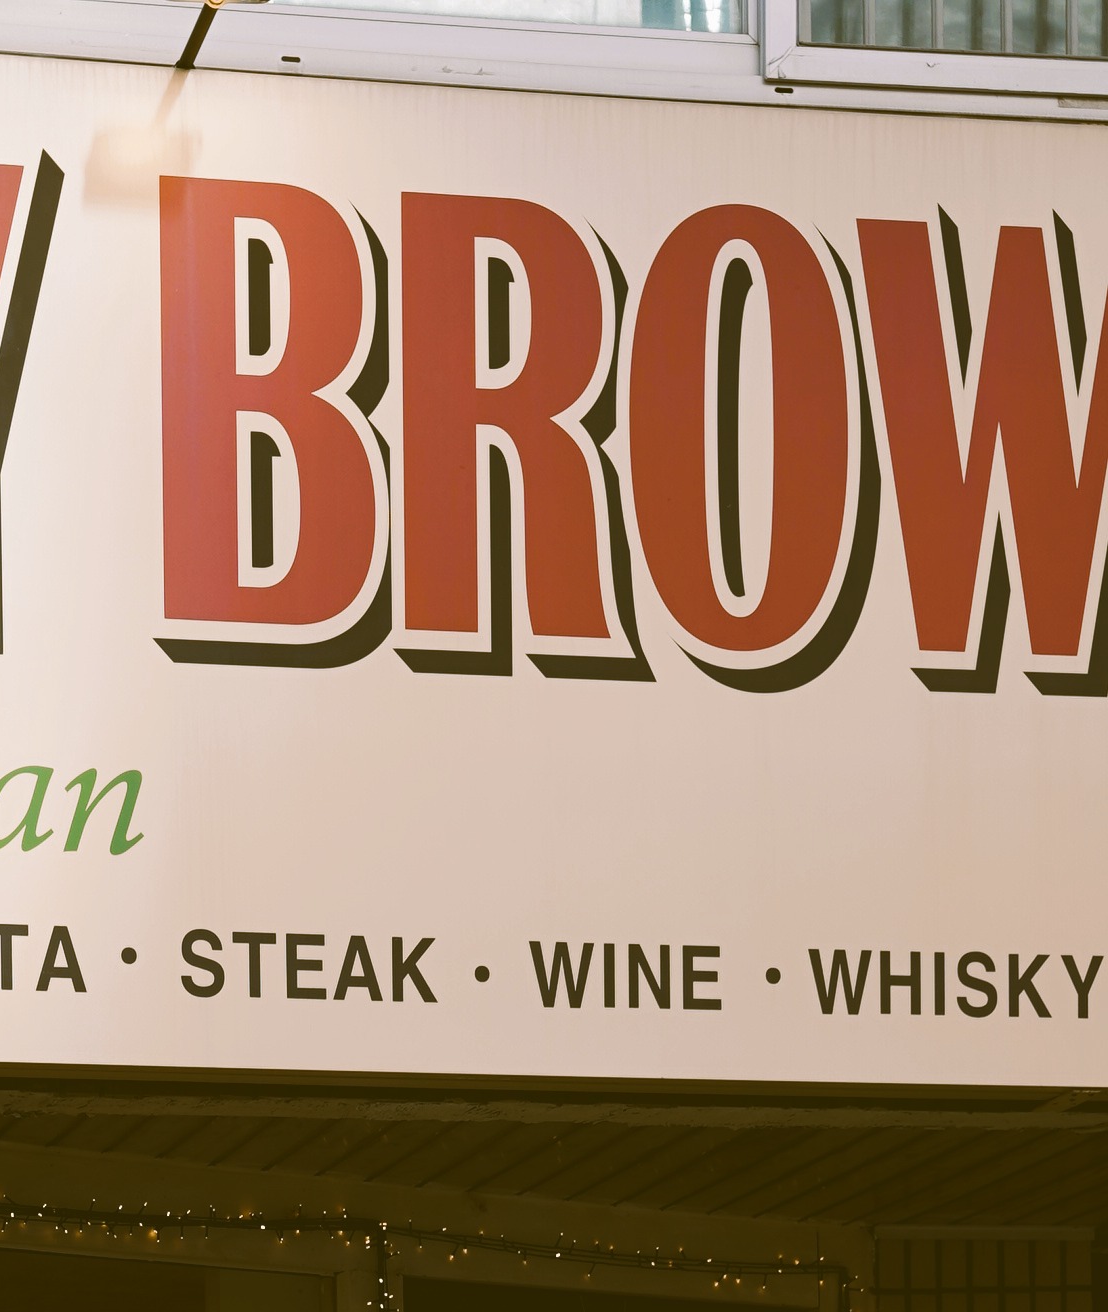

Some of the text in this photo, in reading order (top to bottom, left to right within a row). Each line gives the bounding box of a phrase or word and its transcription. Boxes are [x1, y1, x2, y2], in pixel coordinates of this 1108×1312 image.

[180, 928, 438, 1003] STEAK
[529, 940, 723, 1011] WINE
[808, 948, 1104, 1019] WHISKY
